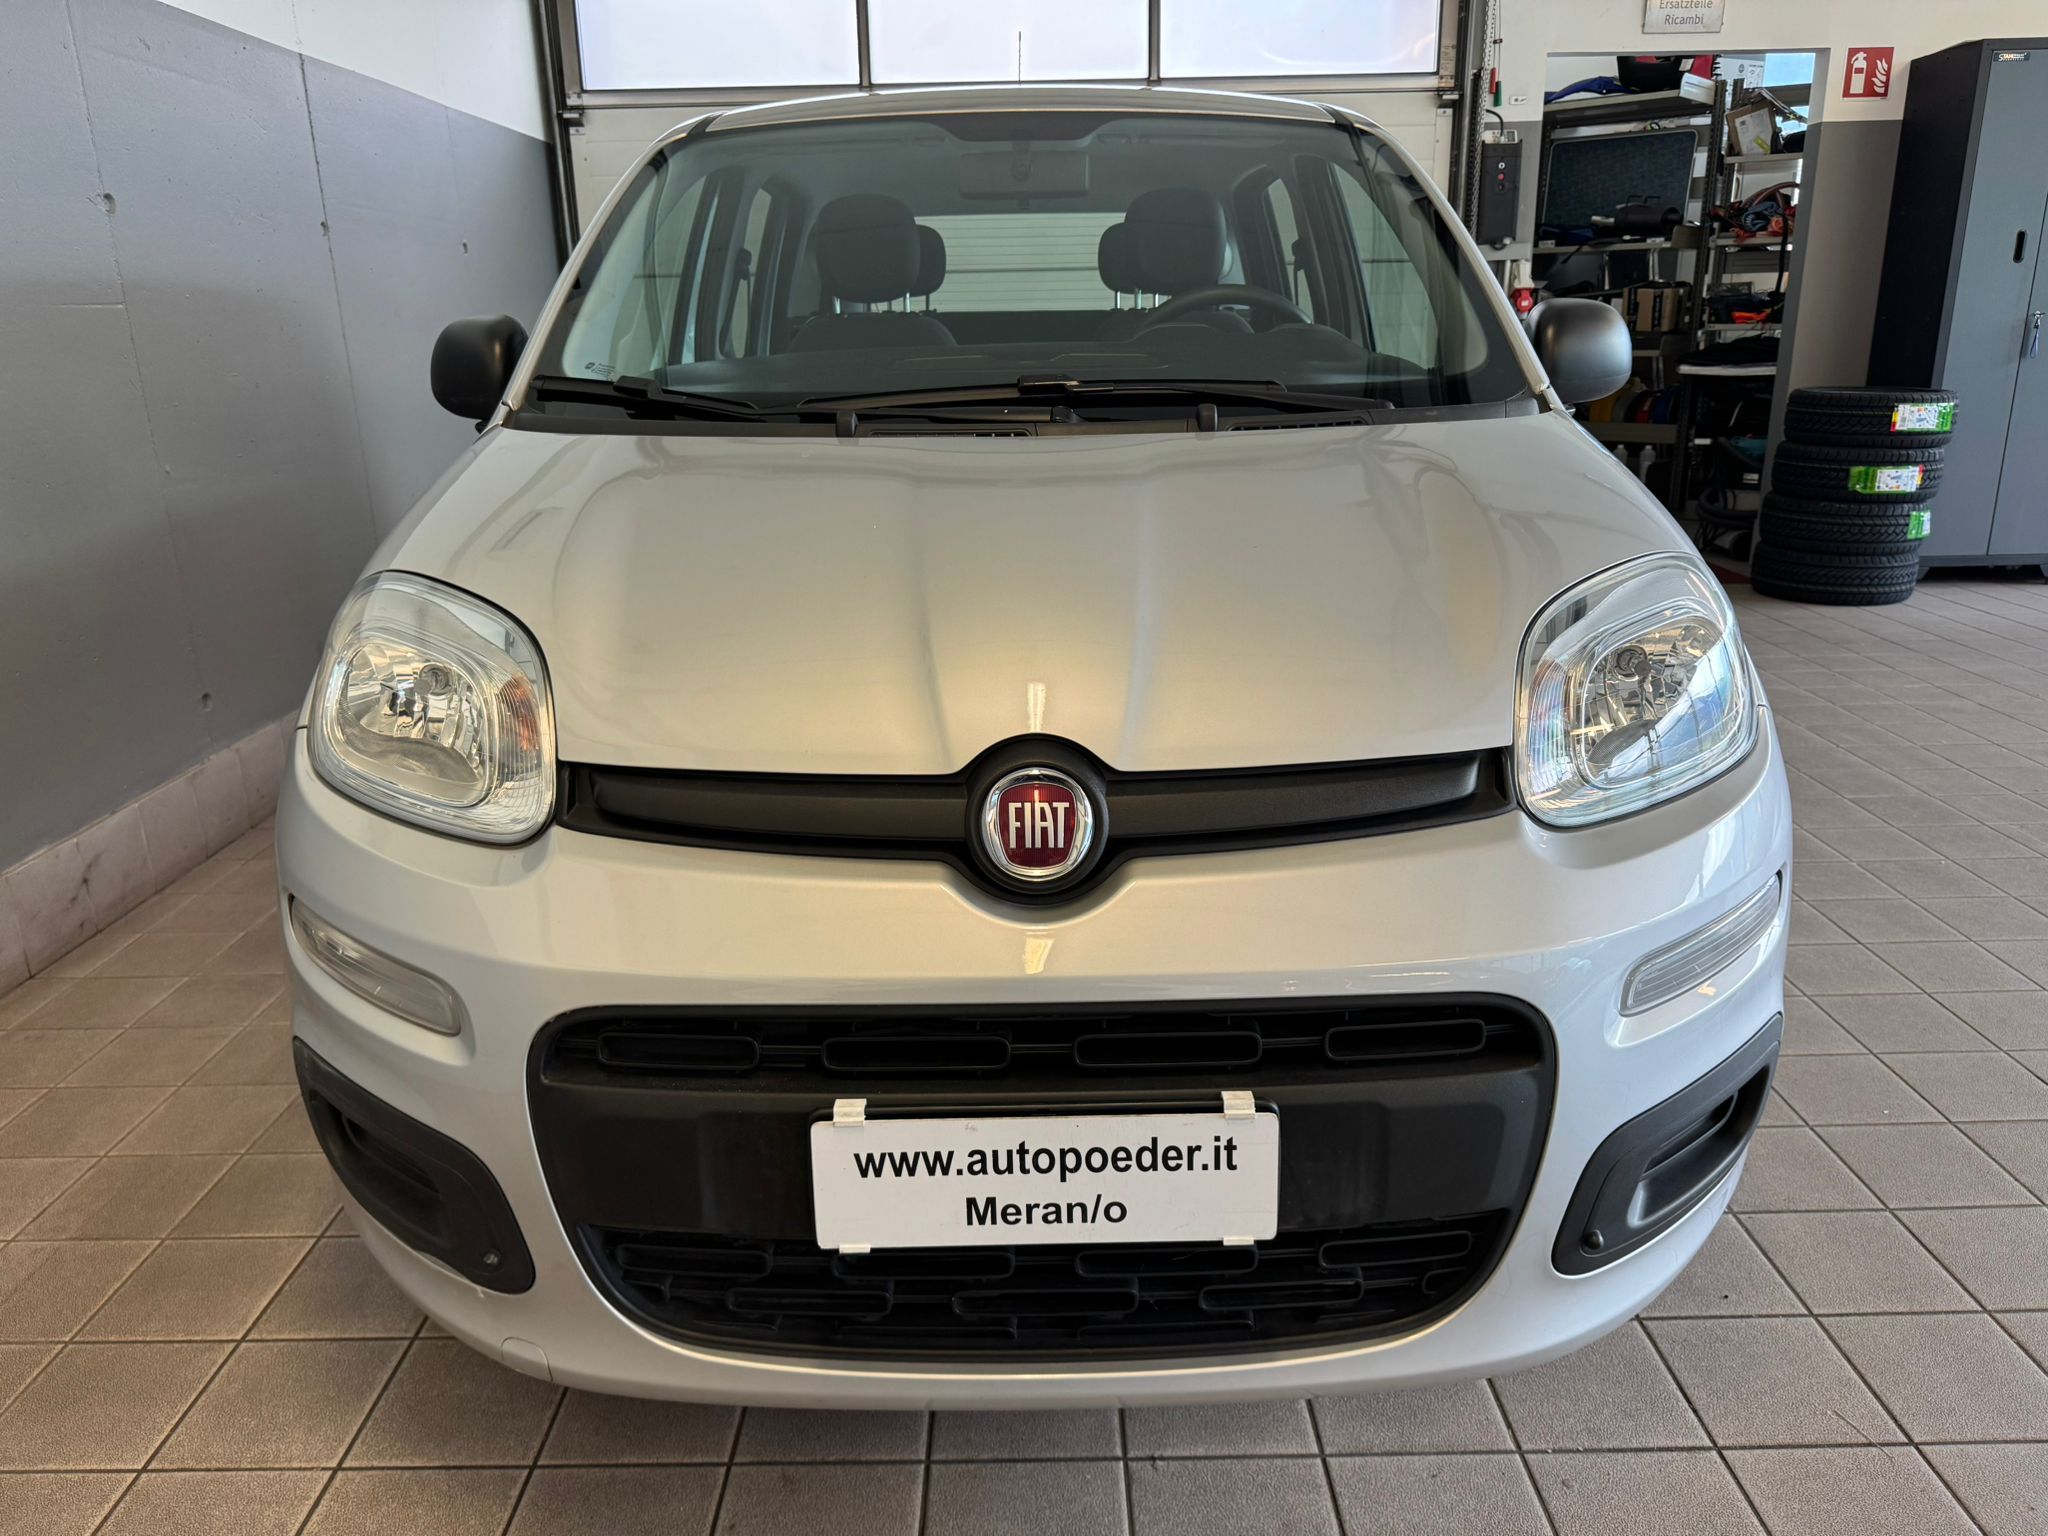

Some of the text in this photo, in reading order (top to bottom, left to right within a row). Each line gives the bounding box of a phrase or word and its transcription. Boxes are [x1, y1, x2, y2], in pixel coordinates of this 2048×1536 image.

[1659, 0, 1713, 9] Ersatzteile
[1664, 14, 1705, 25] Ricambi
[1008, 802, 1070, 849] FIAT
[853, 1136, 1238, 1183] www.autopoeder.it
[965, 1194, 1128, 1225] Meran/o
